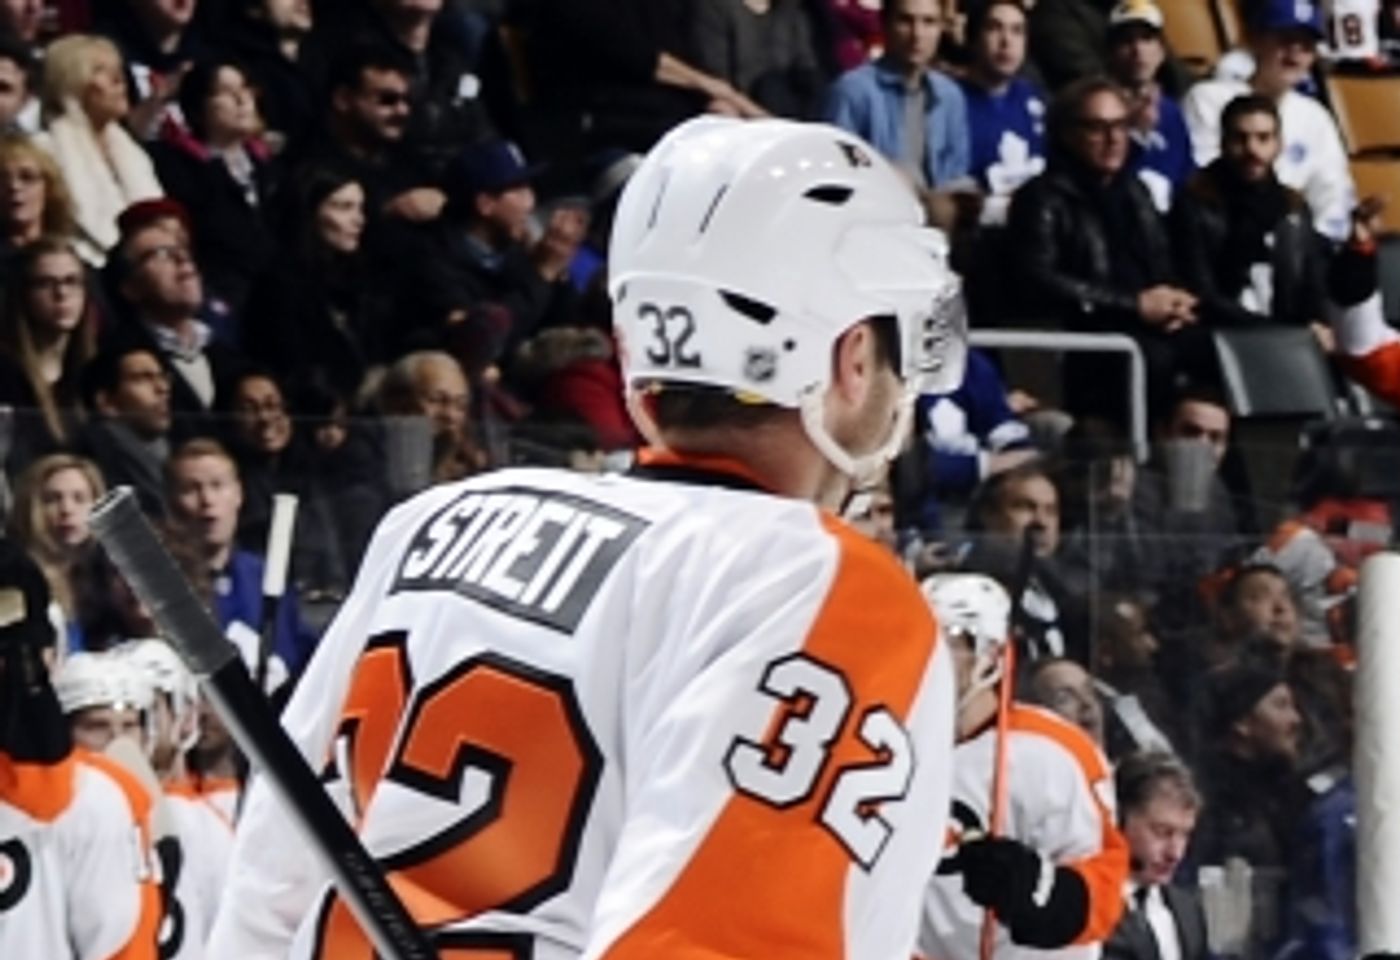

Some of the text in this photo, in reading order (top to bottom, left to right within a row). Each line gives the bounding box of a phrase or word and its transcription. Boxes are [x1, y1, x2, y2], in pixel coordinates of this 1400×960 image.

[637, 302, 702, 370] 32
[400, 494, 628, 614] STREIT
[722, 651, 917, 874] 32
